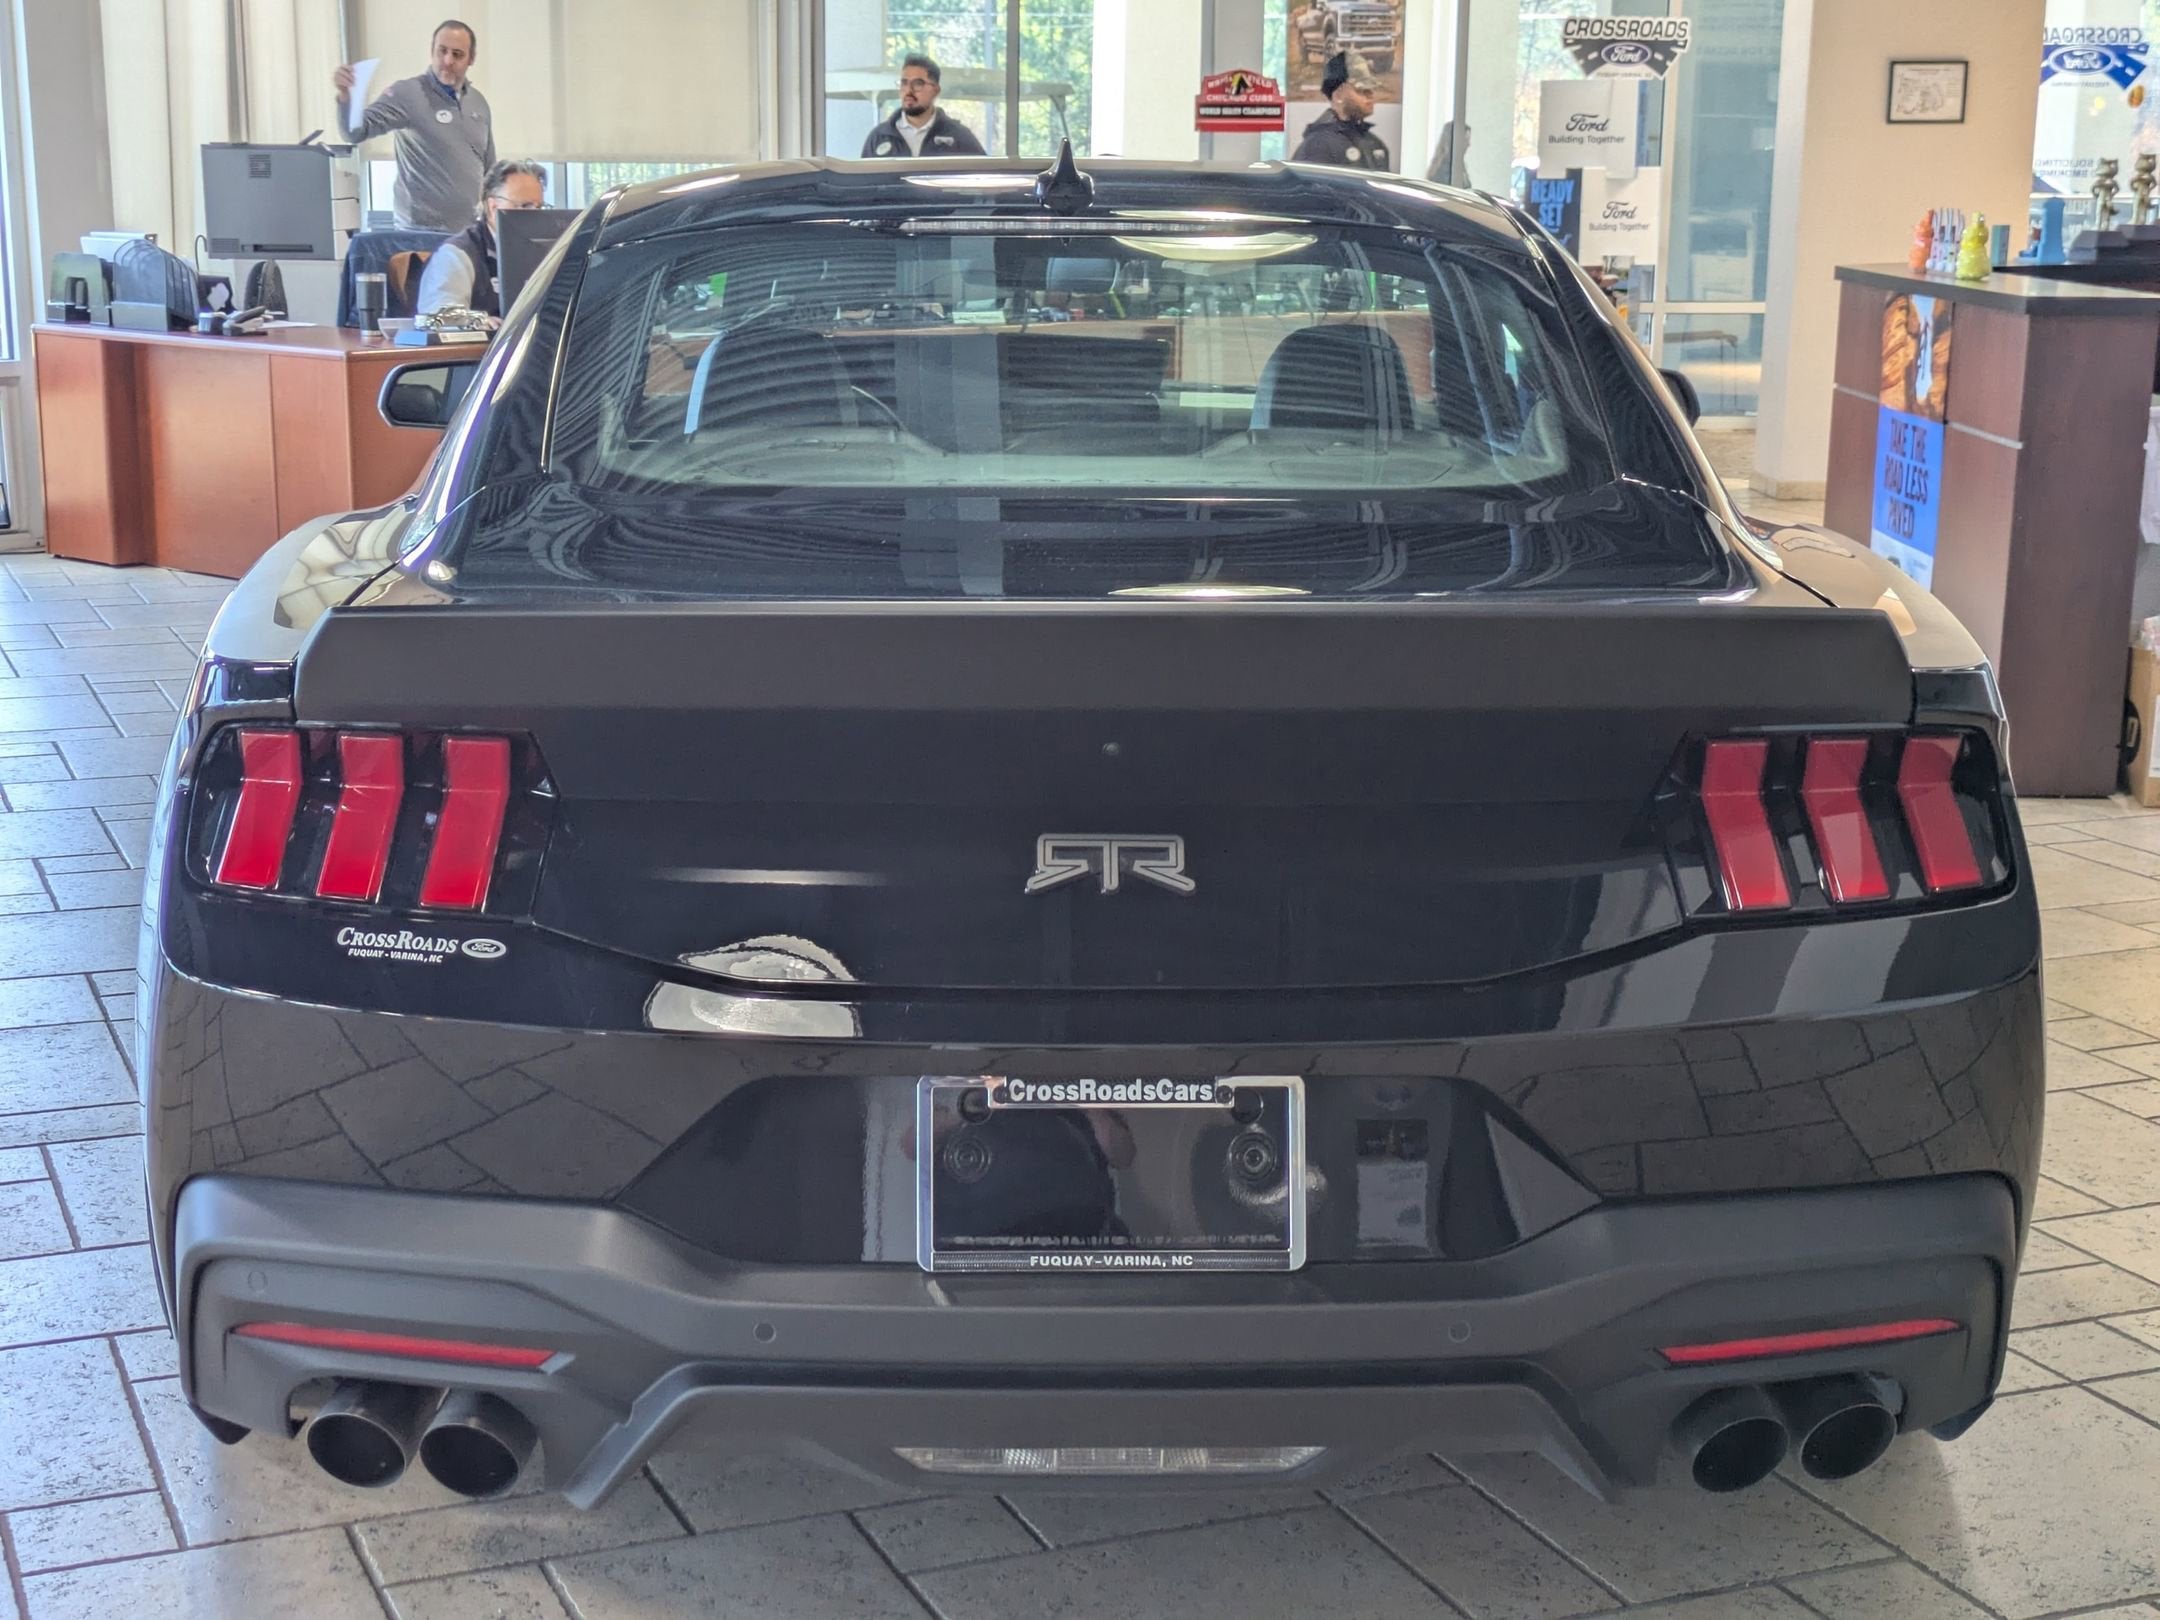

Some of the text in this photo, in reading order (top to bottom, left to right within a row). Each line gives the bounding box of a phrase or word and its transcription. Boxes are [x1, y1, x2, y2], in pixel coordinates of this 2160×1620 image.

[1563, 18, 1688, 39] CROSSROADS
[1610, 45, 1643, 63] Ford
[1249, 94, 1273, 102] CUBS
[1565, 113, 1610, 132] Ford
[1548, 135, 1625, 145] Building Together
[1530, 179, 1575, 204] READY
[1538, 203, 1565, 227] SET
[1602, 201, 1638, 219] Ford
[1588, 222, 1650, 232] Building Together
[1889, 417, 1928, 465] TAKE THE
[1883, 454, 1929, 505] ROAD LESS
[1887, 496, 1915, 539] PAVED
[429, 953, 444, 963] NC
[1009, 1078, 1213, 1102] CrossRoadsCars
[1172, 1255, 1193, 1267] NC
